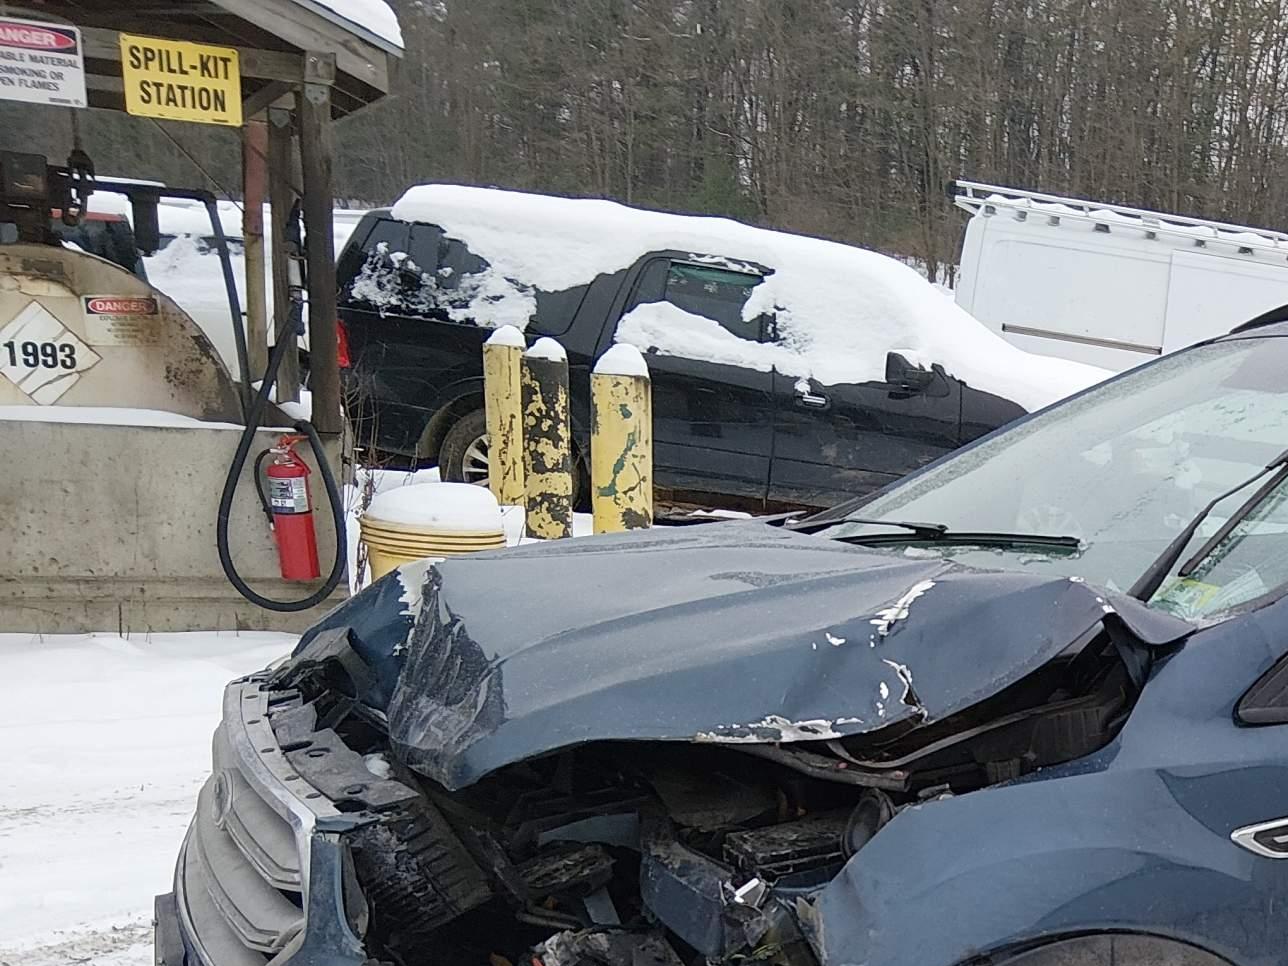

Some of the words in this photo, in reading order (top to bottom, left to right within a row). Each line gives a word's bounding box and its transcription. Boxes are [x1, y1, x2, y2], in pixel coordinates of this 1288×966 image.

[28, 54, 80, 69] MATERIAL
[129, 45, 232, 80] SPILL-KIT
[49, 70, 65, 81] OR
[18, 78, 60, 92] FLAMES
[139, 80, 226, 113] STATION
[95, 301, 147, 312] DANGER
[3, 340, 77, 370] 1993
